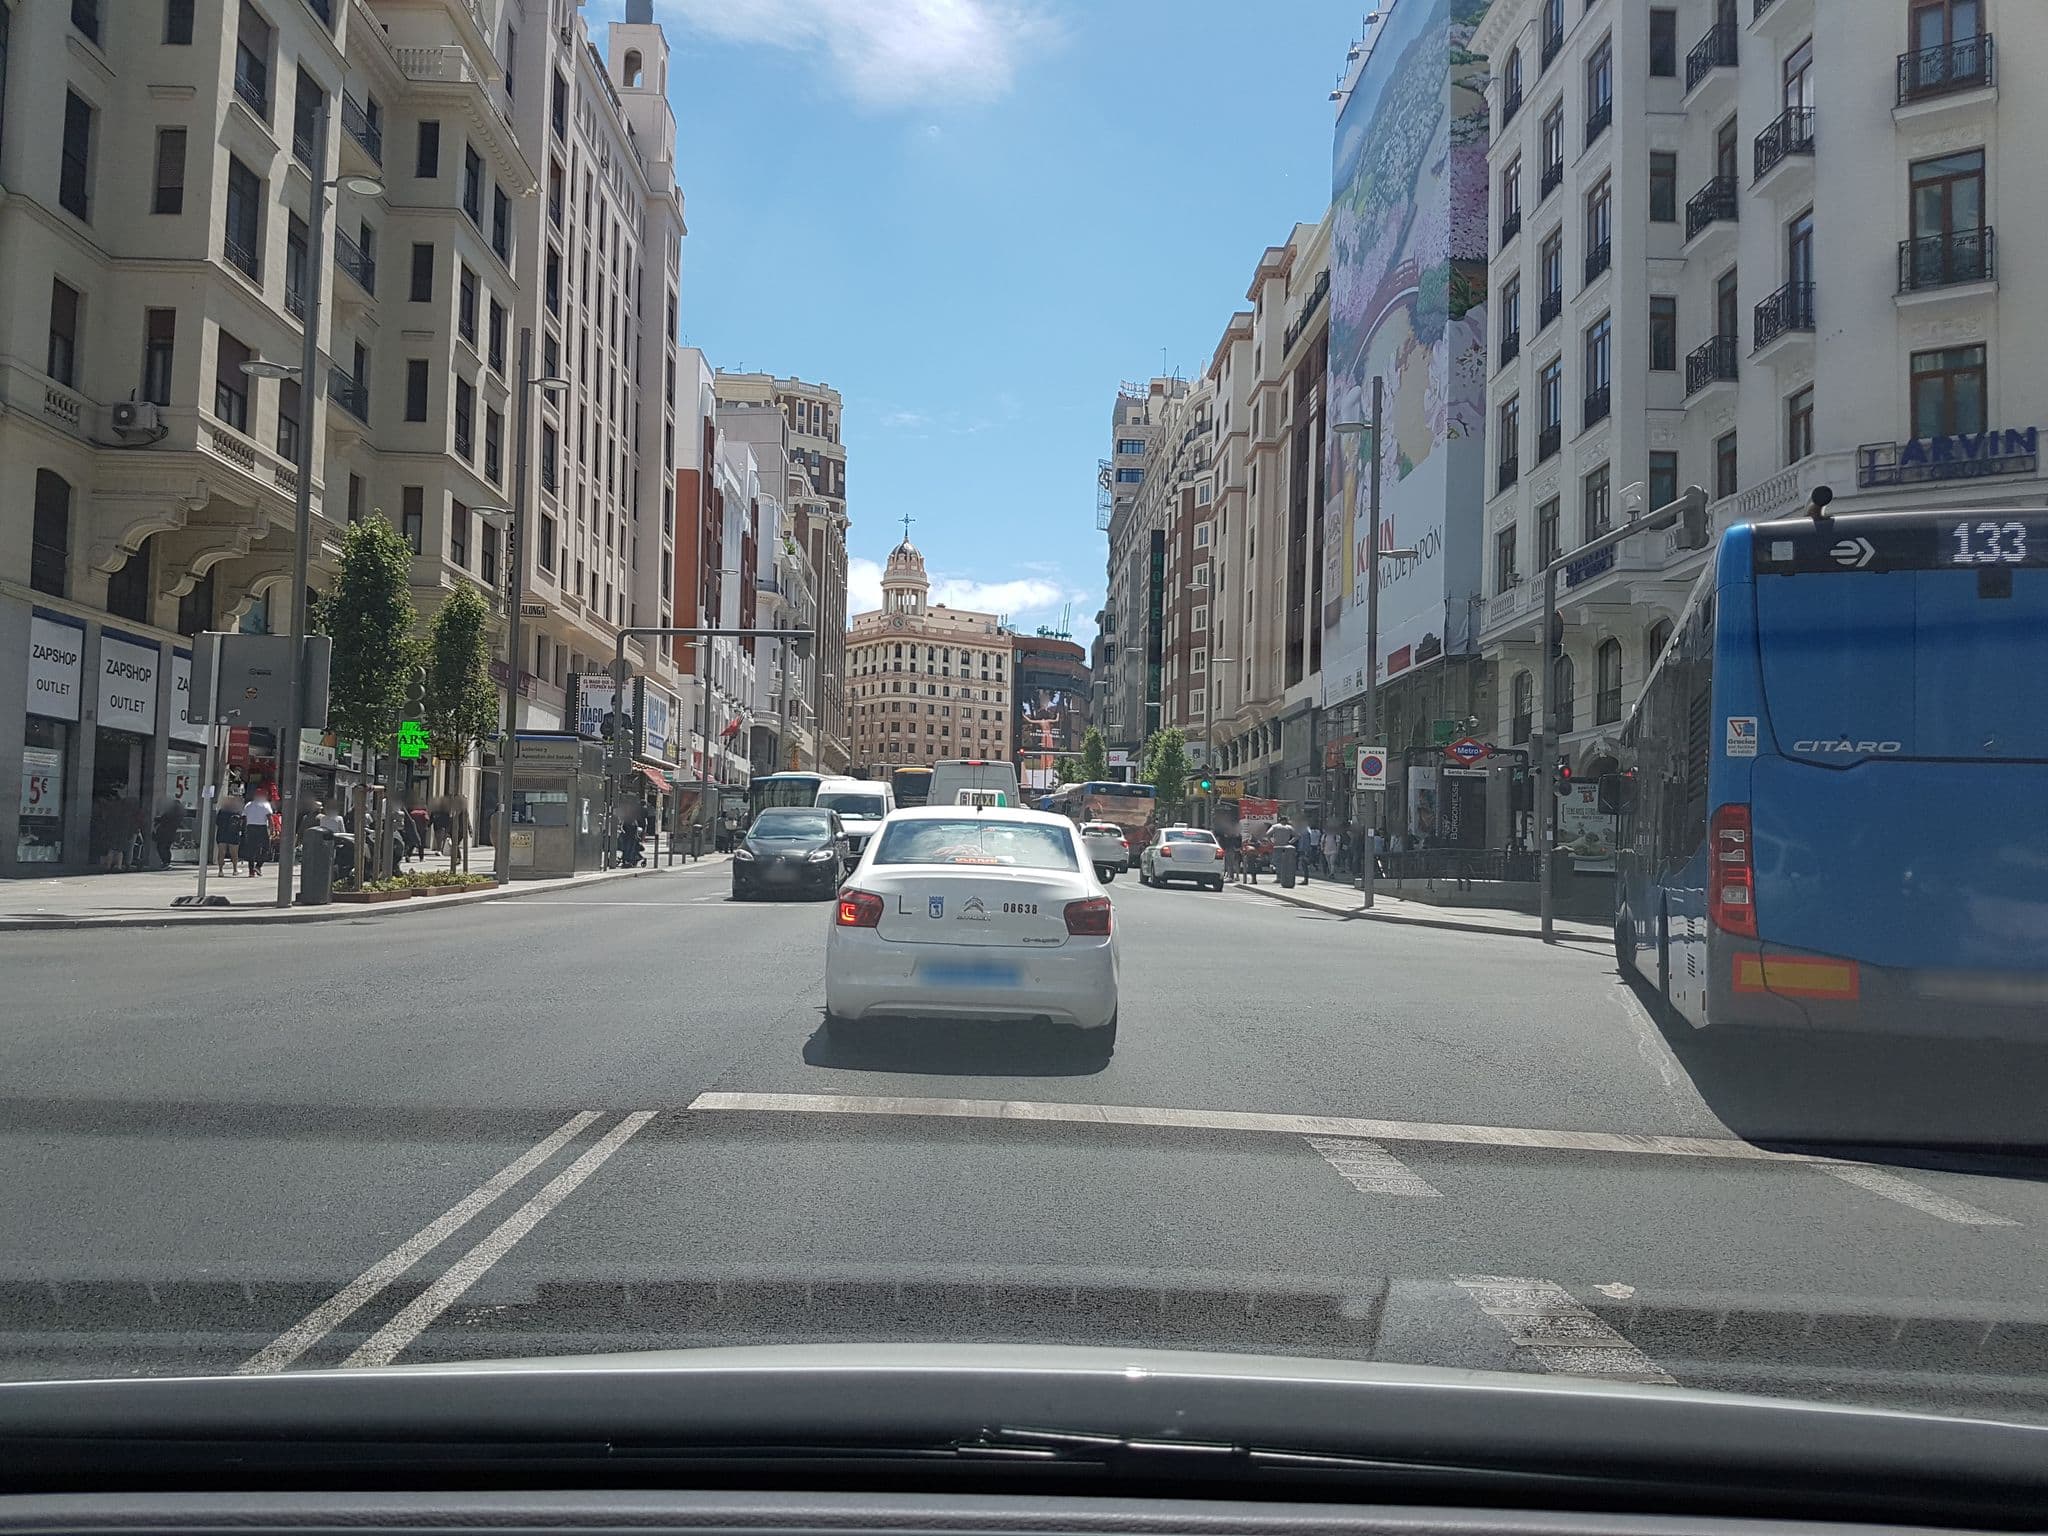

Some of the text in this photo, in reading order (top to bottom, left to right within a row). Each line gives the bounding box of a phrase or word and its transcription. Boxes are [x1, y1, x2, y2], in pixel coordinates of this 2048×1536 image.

[1356, 513, 1395, 577] KIIN
[1408, 524, 1442, 579] JAPÓN
[1953, 521, 2027, 562] 133
[33, 644, 77, 667] ZAPSHOP
[106, 658, 153, 684] ZAPSHOP
[36, 678, 71, 696] OUTLET
[110, 694, 146, 714] OUTLET
[580, 691, 590, 707] EL
[579, 707, 604, 724] MAGO
[1457, 747, 1479, 755] Metro
[1792, 740, 1902, 754] CITARO
[29, 776, 49, 805] 5€
[175, 775, 190, 799] 5€
[972, 793, 996, 806] TAXI
[898, 895, 913, 915] L
[1003, 902, 1038, 915] 08638
